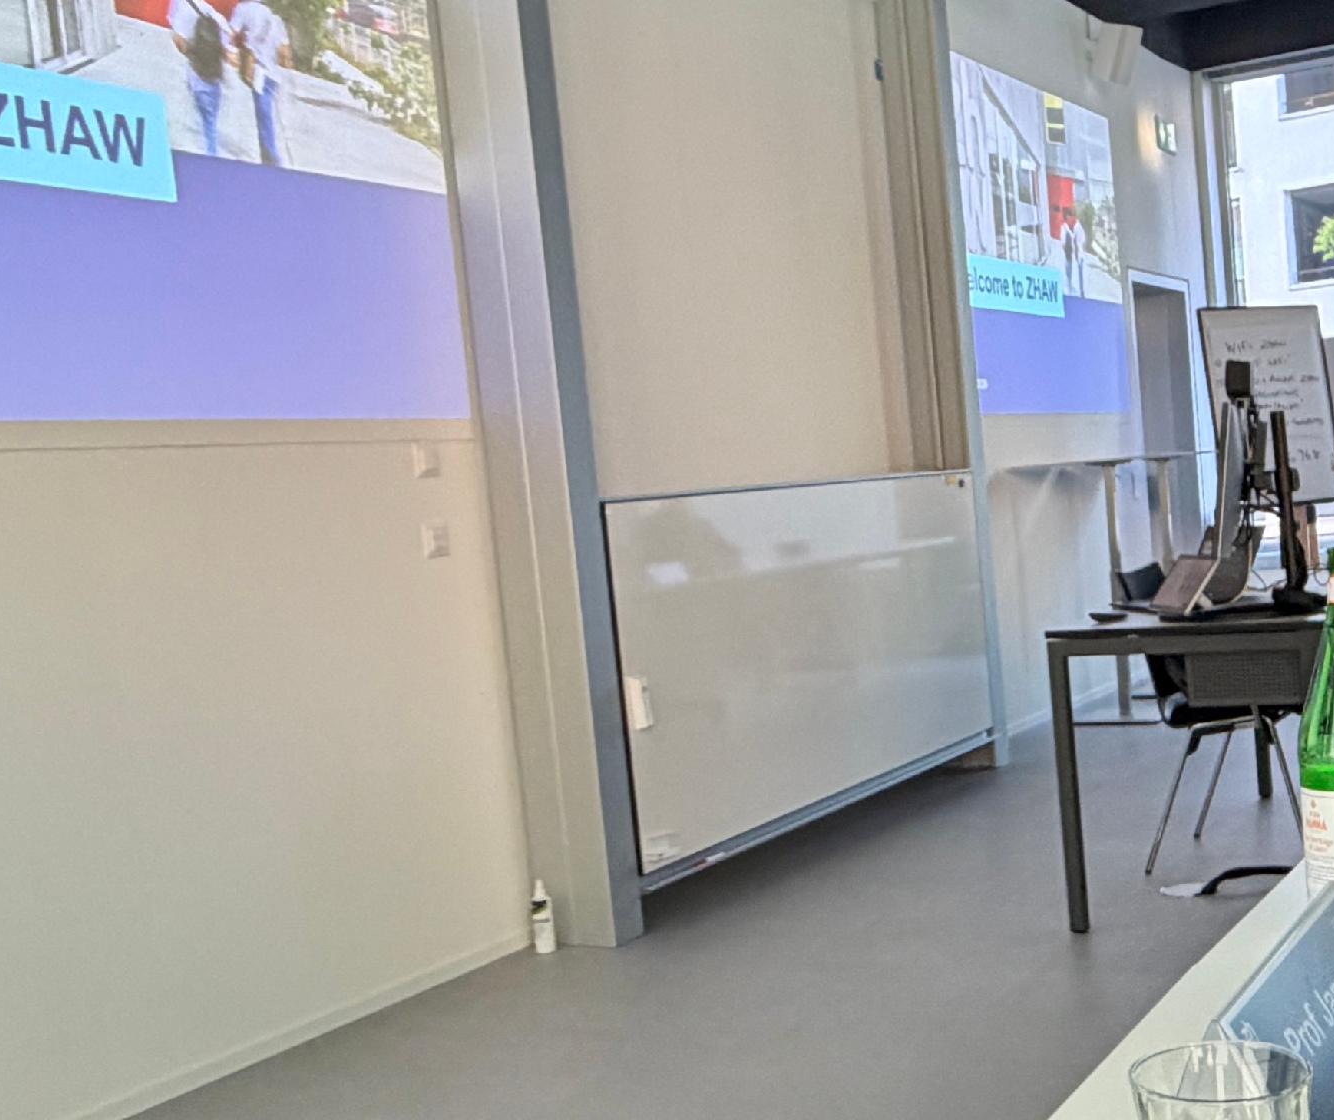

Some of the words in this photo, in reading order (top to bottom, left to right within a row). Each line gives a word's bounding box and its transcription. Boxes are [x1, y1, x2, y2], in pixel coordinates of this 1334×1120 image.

[1012, 275, 1024, 300] to
[1026, 276, 1059, 303] ZHAW
[1283, 1001, 1327, 1056] Prof
